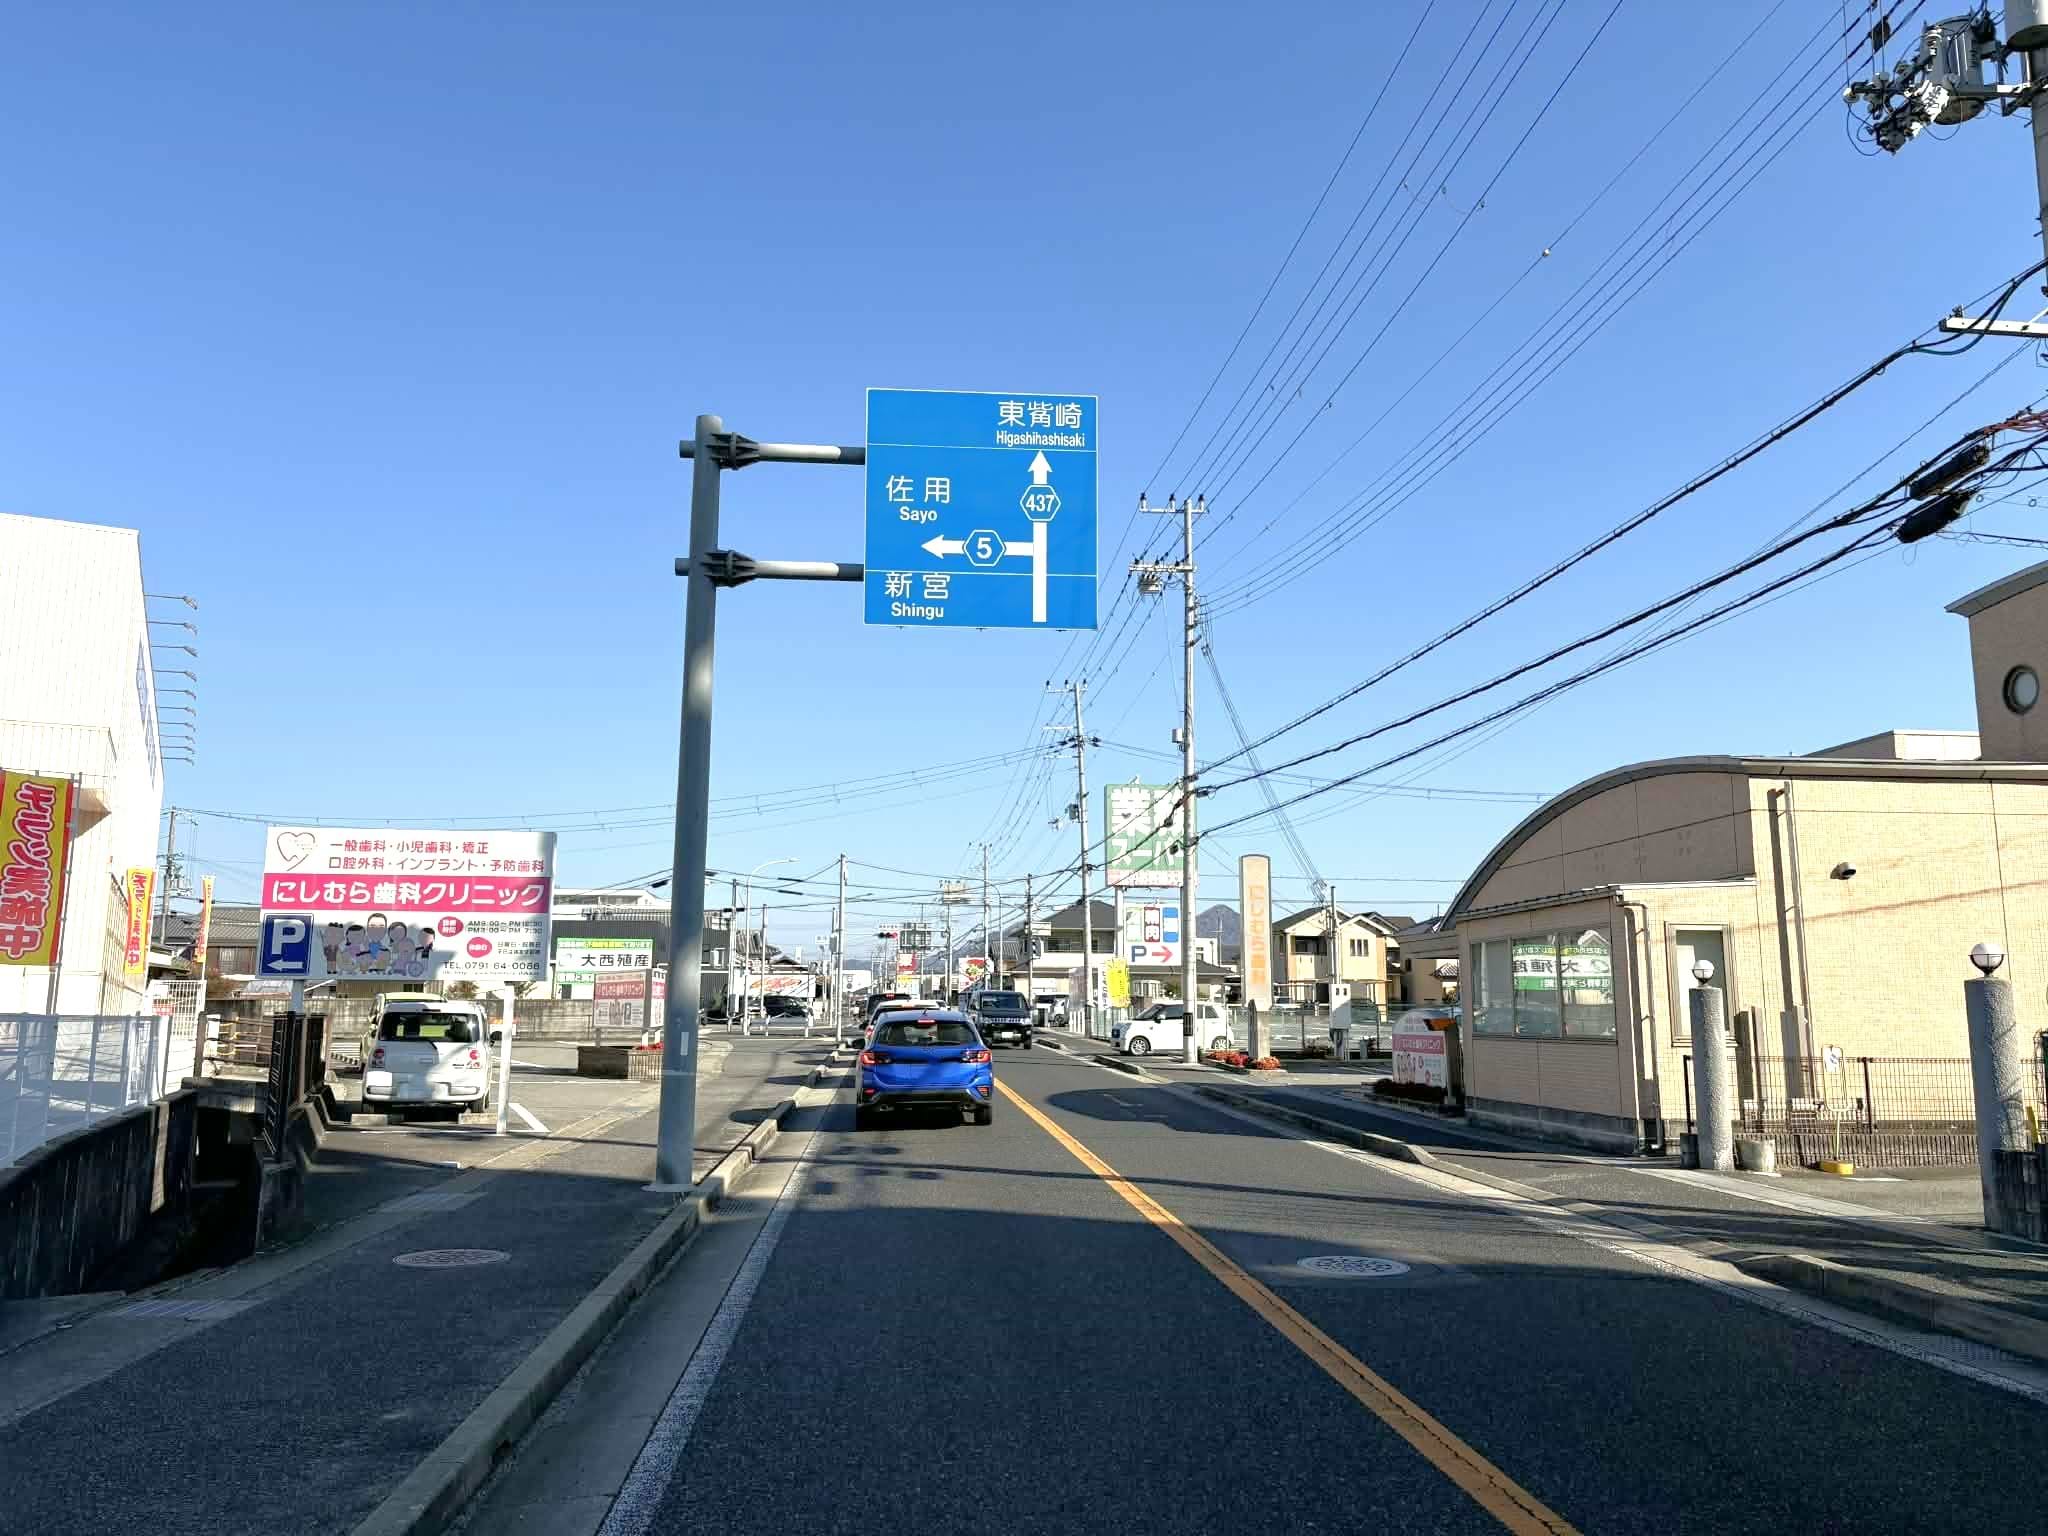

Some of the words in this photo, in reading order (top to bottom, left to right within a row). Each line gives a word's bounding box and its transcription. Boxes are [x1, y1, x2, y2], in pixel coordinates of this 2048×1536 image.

[996, 430, 1085, 447] Higashihashisaki
[886, 475, 950, 504] 佐用
[1025, 494, 1055, 512] 437
[899, 506, 938, 524] Sayo
[976, 537, 992, 559] 5
[884, 571, 950, 600] 新宮
[891, 602, 944, 620] Shingu
[271, 880, 545, 907] にしむら歯科クリニック
[271, 918, 305, 956] P
[580, 953, 649, 967] 大西殖産
[1131, 945, 1147, 963] P
